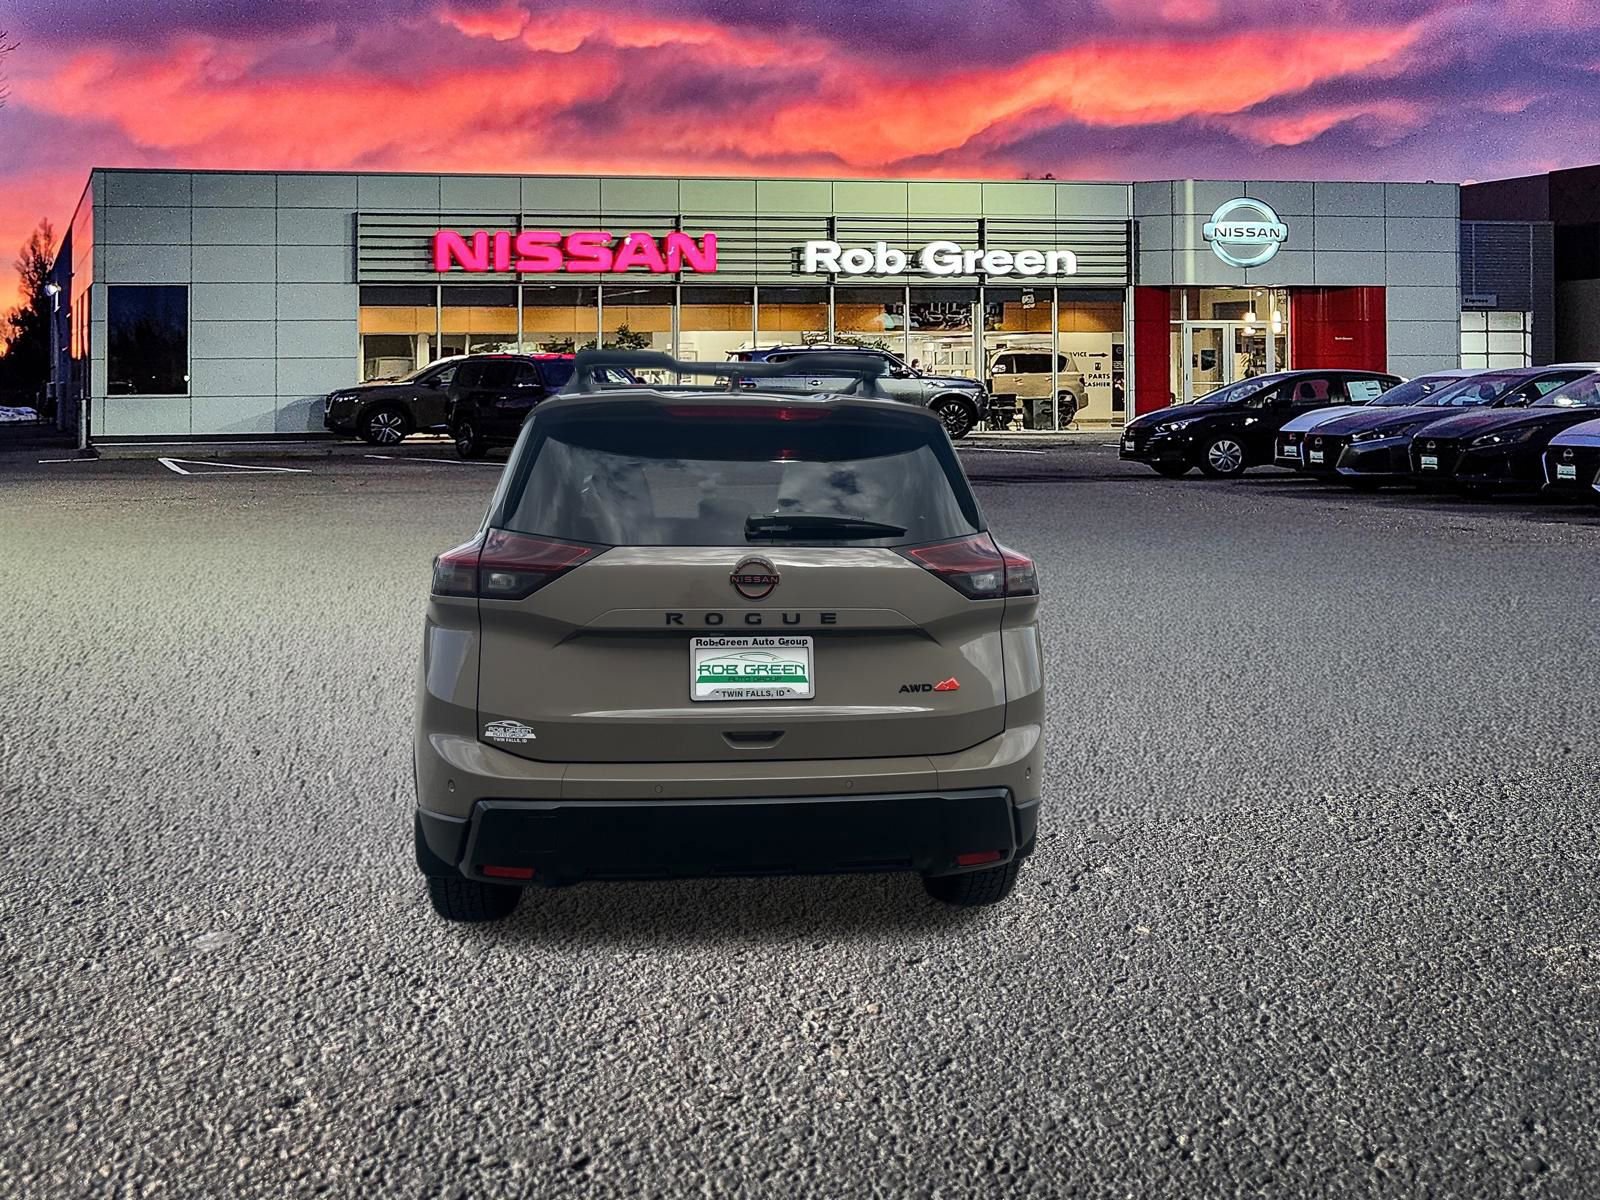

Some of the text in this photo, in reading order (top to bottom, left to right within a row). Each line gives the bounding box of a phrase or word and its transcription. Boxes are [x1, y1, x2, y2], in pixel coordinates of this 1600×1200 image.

[1214, 227, 1280, 238] NISSAN
[433, 231, 718, 273] NISSAN
[804, 240, 1077, 276] Rob Green
[731, 575, 779, 583] NISSAN
[664, 612, 838, 626] ROGUE
[695, 638, 808, 648] Rob Green Auto Group
[697, 664, 806, 675] ROB GREEN
[721, 690, 743, 698] TWIN
[745, 690, 773, 698] FALLS,
[898, 683, 933, 694] AWD
